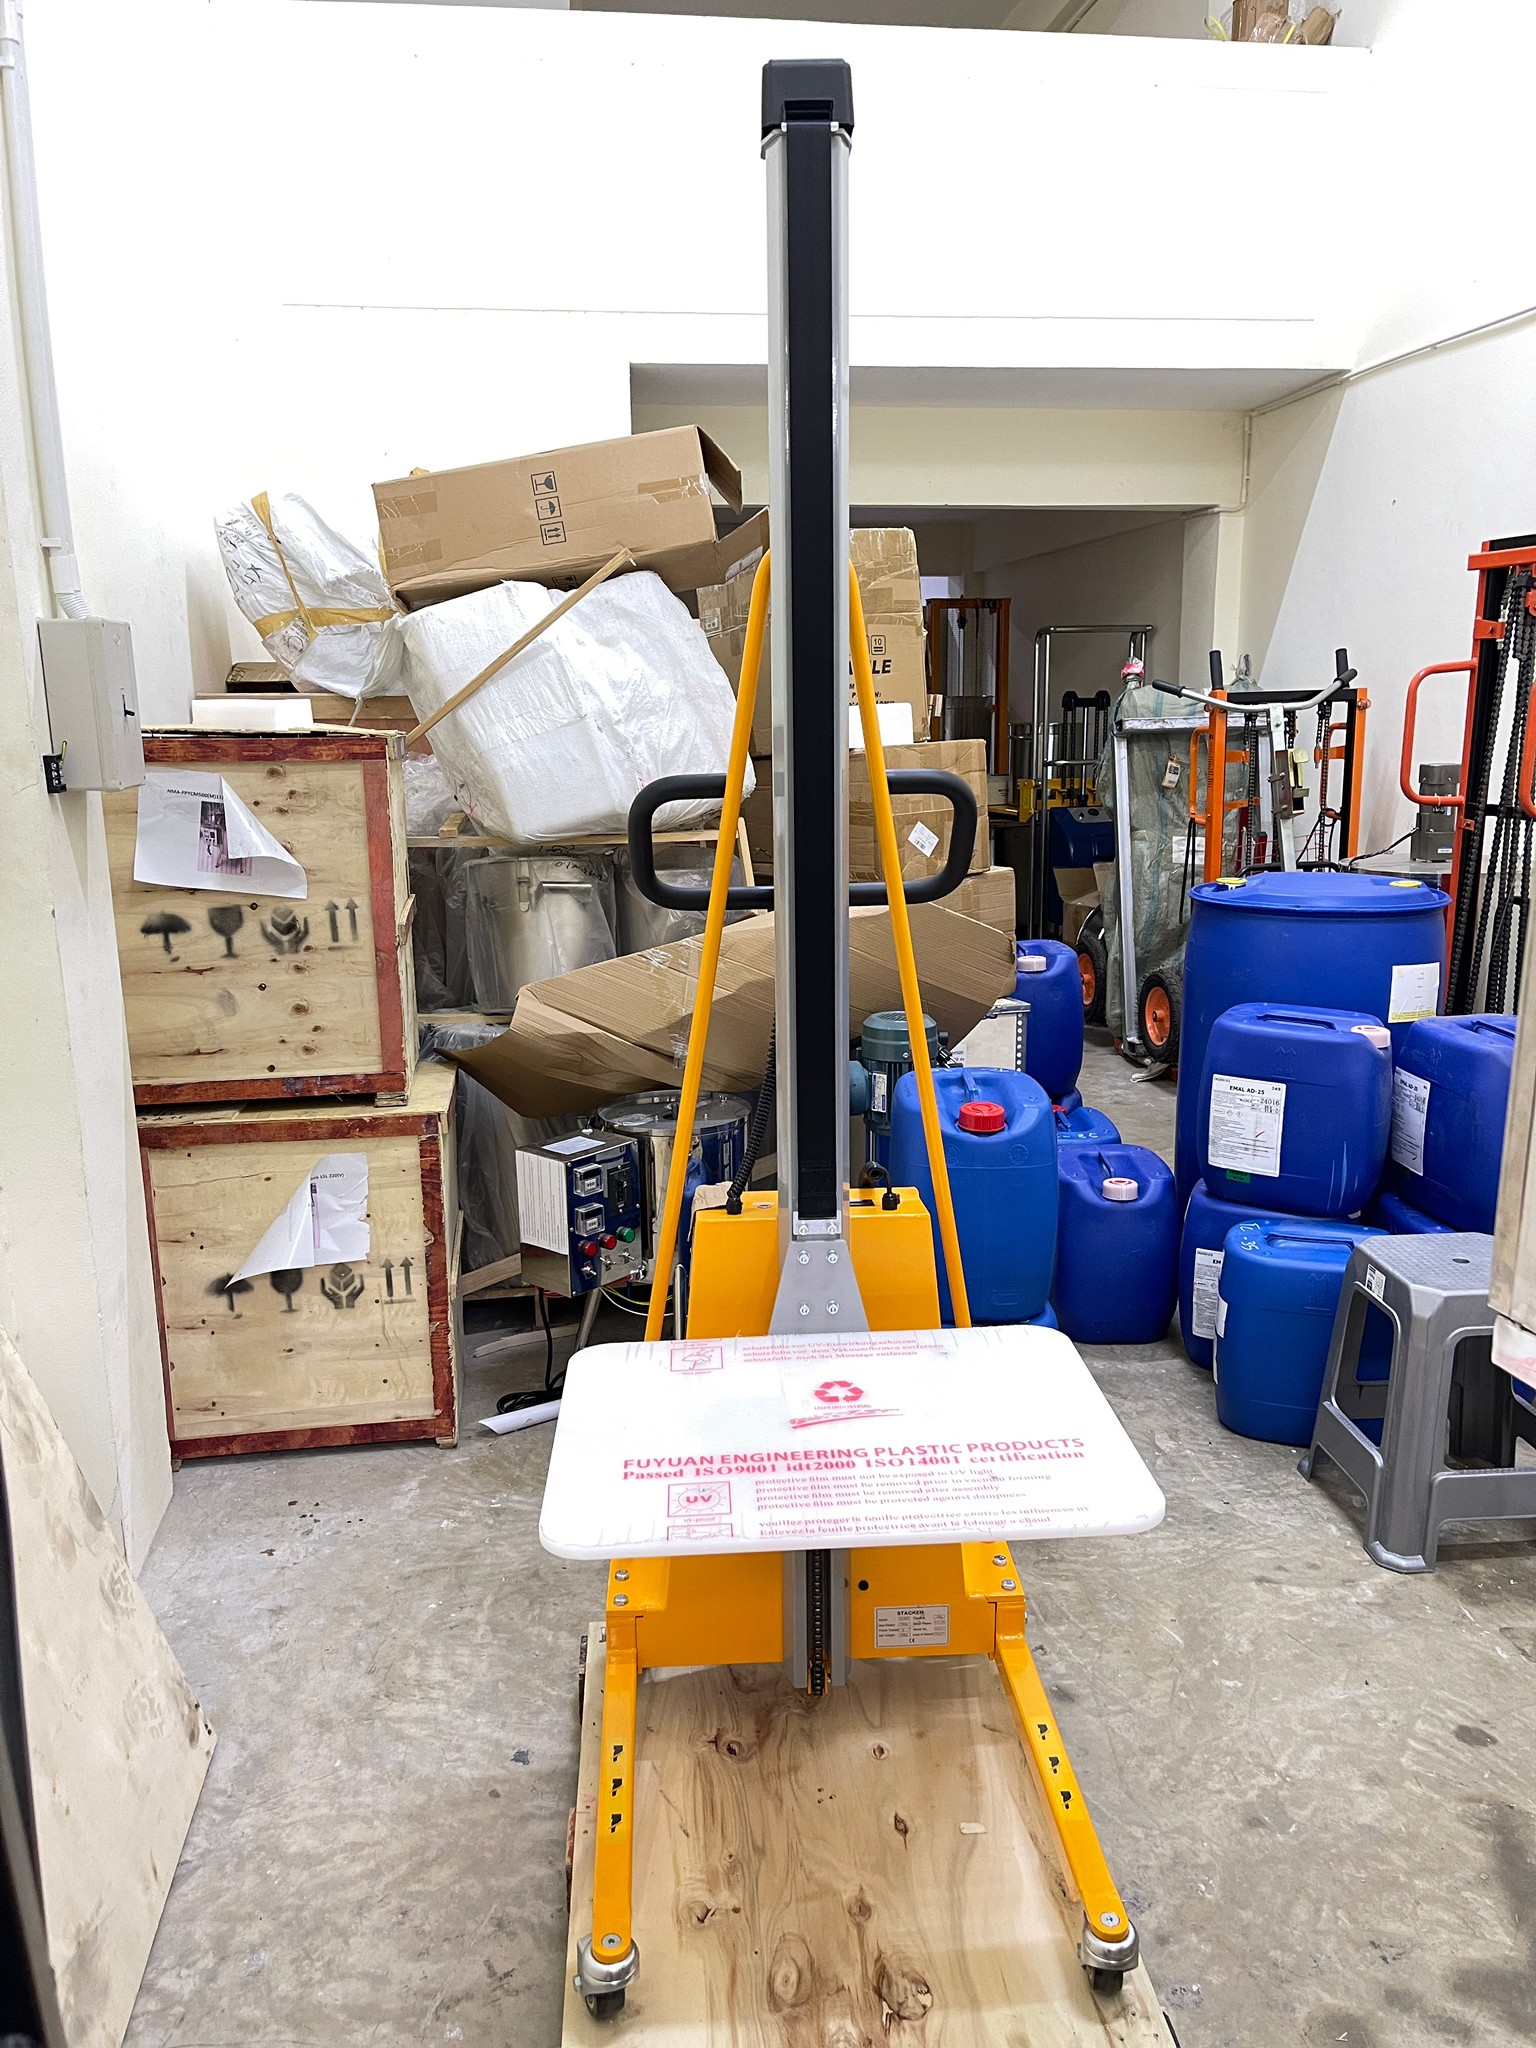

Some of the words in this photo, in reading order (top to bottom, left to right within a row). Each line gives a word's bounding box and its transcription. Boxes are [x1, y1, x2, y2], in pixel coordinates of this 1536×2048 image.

[623, 1455, 714, 1469] FUYUAN
[720, 1448, 868, 1464] ENGINEERING
[874, 1444, 963, 1457] PLASTIC
[966, 1438, 1085, 1453] PRODUCTS
[622, 1468, 684, 1480] Passed
[695, 1463, 777, 1476] ISO9001
[786, 1460, 857, 1471] idt2000
[866, 1455, 960, 1468] ISO14001
[969, 1450, 1085, 1463] certification
[755, 1477, 807, 1486] protective
[859, 1472, 876, 1480] not
[892, 1470, 935, 1479] exposed
[756, 1485, 808, 1494] protective
[876, 1479, 921, 1487] removed
[757, 1493, 809, 1502] protective
[878, 1487, 923, 1495] removed
[952, 1484, 999, 1492] assembly
[686, 1494, 713, 1503] UV
[758, 1501, 811, 1511] protective
[813, 1499, 834, 1507] film
[837, 1498, 862, 1506] must
[880, 1496, 930, 1505] protected
